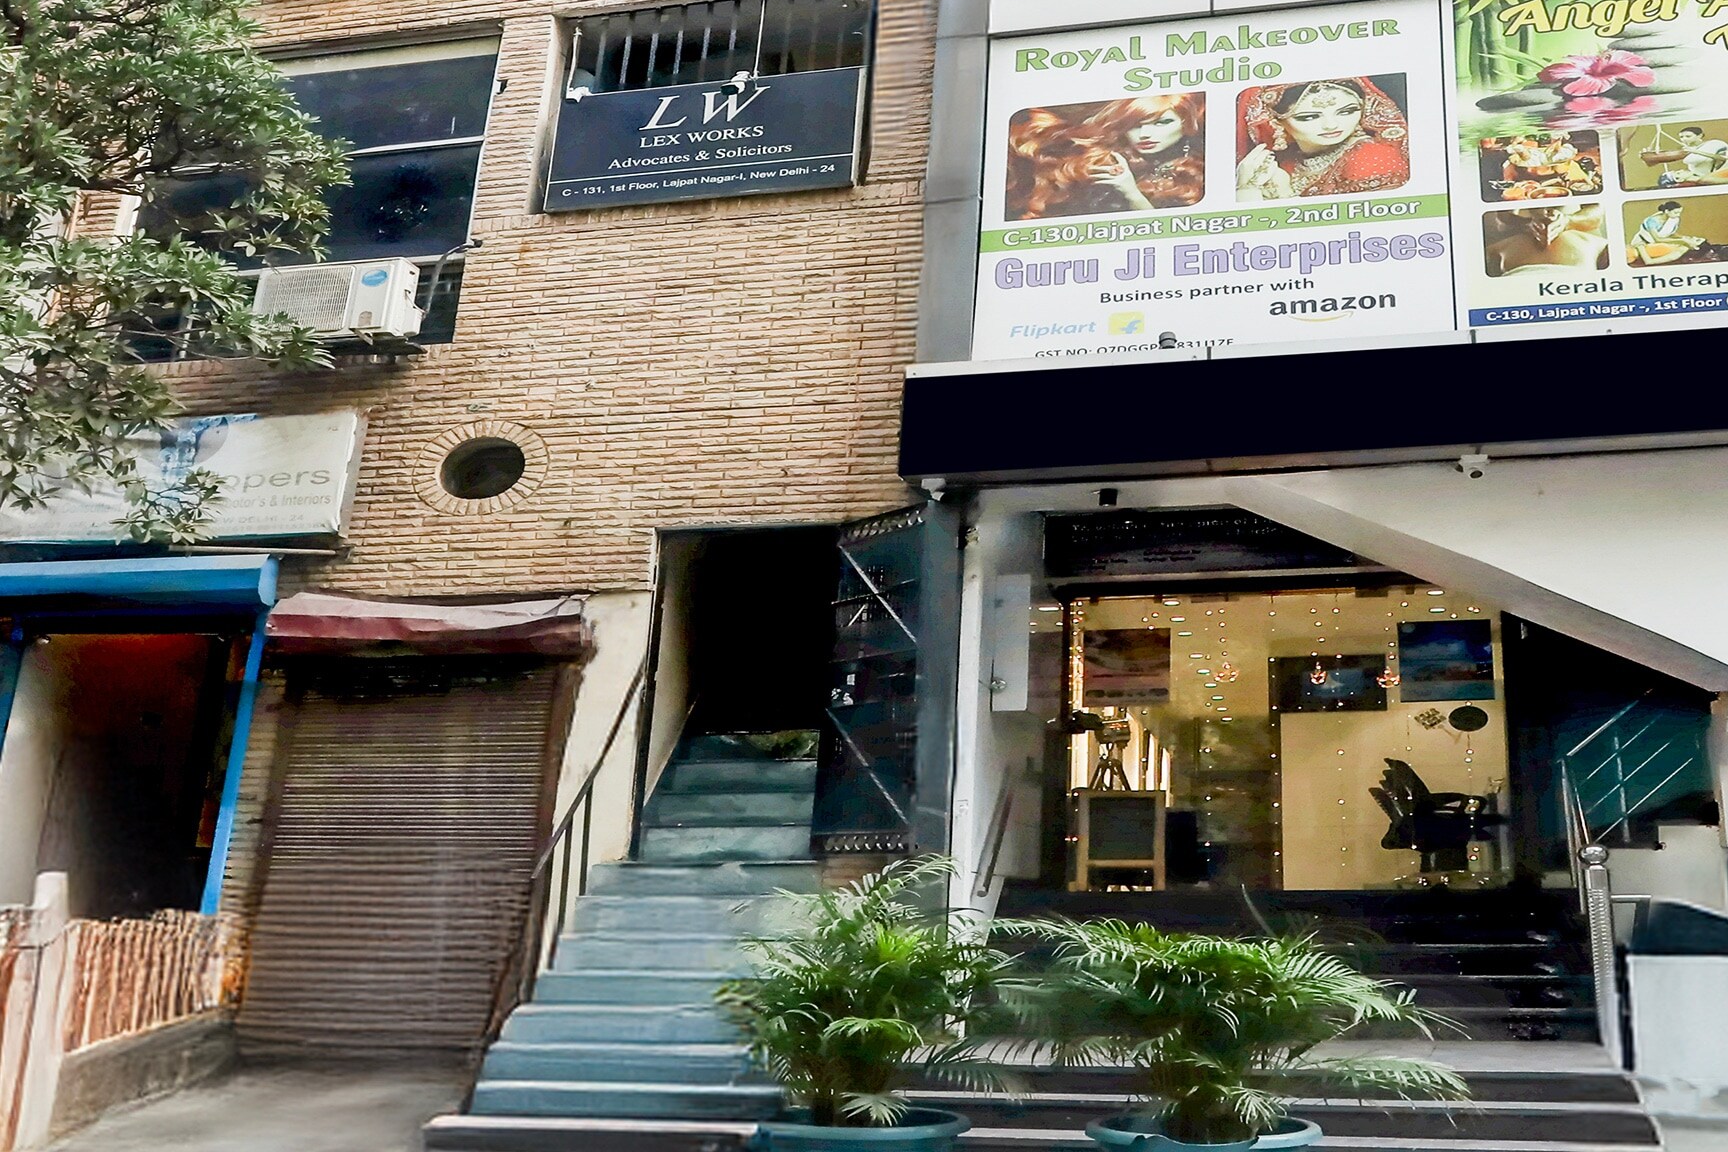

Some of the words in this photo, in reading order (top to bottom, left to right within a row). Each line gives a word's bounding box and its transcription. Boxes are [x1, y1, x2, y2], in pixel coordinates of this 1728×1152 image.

[638, 95, 688, 131] L
[702, 85, 771, 125] W
[640, 133, 681, 148] LEX
[687, 125, 765, 144] WORKS
[608, 152, 690, 170] Advocates
[695, 149, 711, 162] &
[715, 142, 792, 160] Solicitors
[562, 188, 572, 197] C
[582, 186, 605, 196] 131,
[610, 183, 626, 193] 1st
[663, 176, 698, 188] Lajpat
[750, 169, 777, 179] New
[779, 165, 810, 176] Delhi
[820, 164, 835, 173] 24
[1170, 211, 1250, 237] Nagar
[1287, 204, 1339, 226] 2nd
[1347, 198, 1422, 219] Floor
[994, 255, 1099, 290] Guru
[1114, 246, 1156, 282] Ji
[1173, 229, 1446, 276] Enterprises
[1099, 286, 1183, 304] Business
[1189, 282, 1264, 300] partner
[1270, 277, 1315, 292] with
[1538, 277, 1624, 296] Kerala
[1268, 291, 1397, 316] amazon
[1485, 309, 1534, 322] C-130,
[1538, 306, 1585, 319] Lajpat
[1589, 302, 1636, 316] Nagar
[1654, 299, 1679, 310] 1st
[1681, 296, 1723, 308] Floor
[1009, 321, 1097, 340] Flipkart
[282, 494, 332, 506] Interiors
